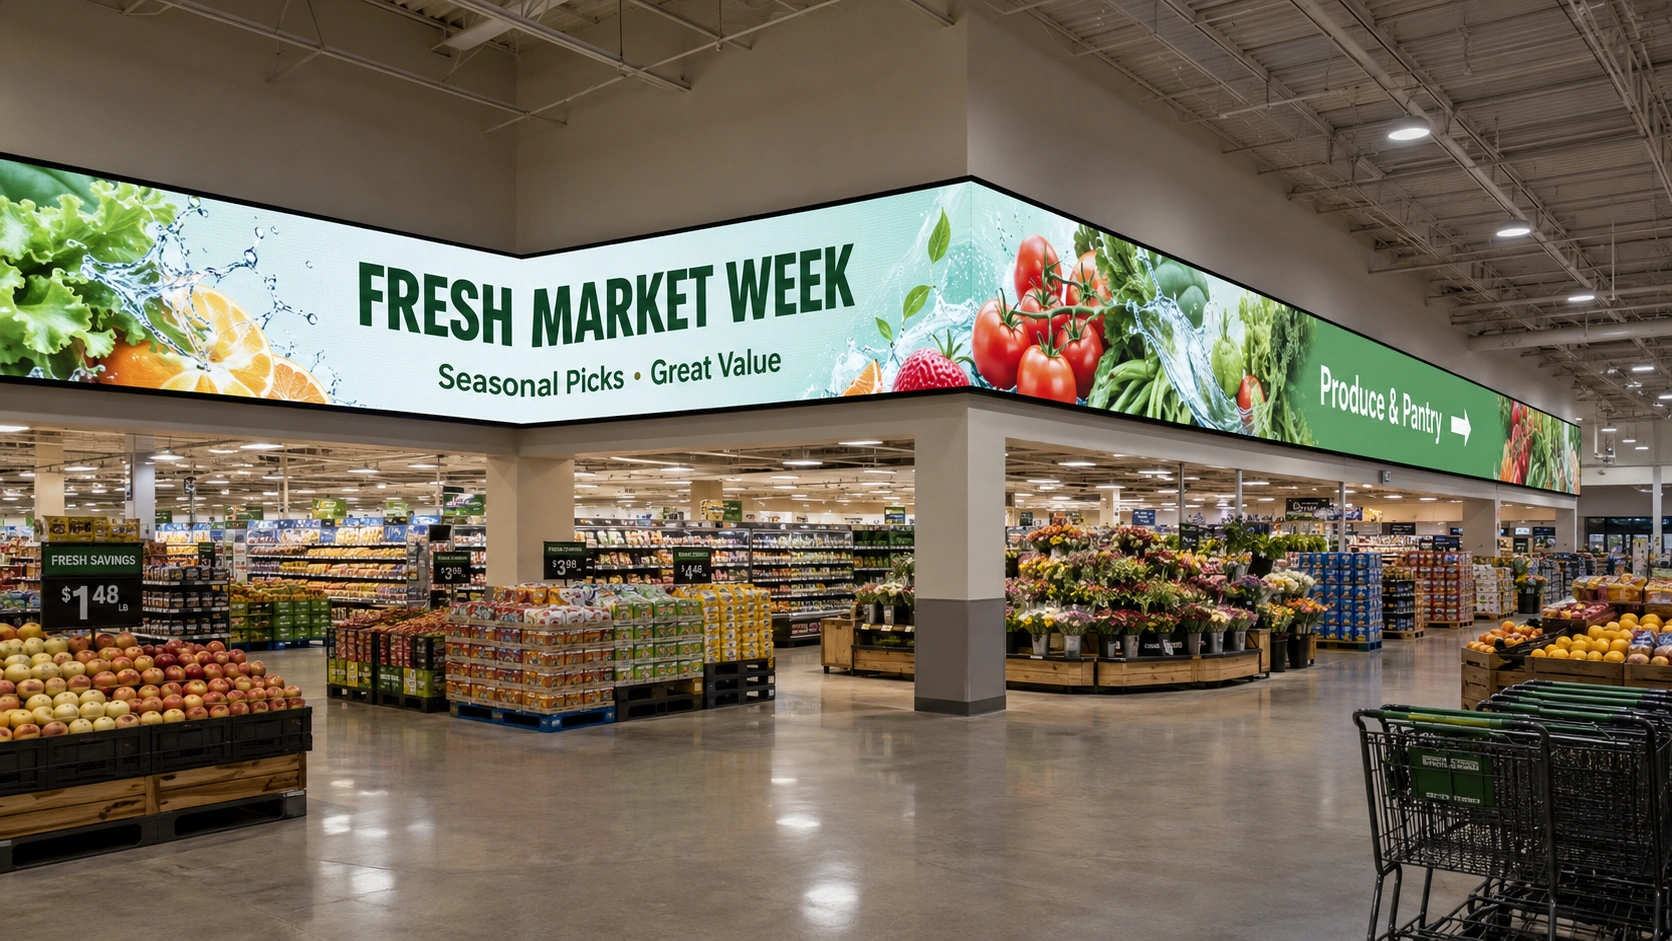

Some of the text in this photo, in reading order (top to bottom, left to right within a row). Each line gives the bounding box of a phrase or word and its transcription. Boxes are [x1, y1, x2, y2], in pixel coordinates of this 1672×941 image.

[359, 243, 855, 348] FRESH MARKET WEEK
[438, 363, 559, 398] Seasonal
[566, 366, 625, 394] Picks
[650, 355, 712, 385] Great
[717, 348, 782, 378] Value
[1320, 364, 1443, 445] Produce & Pantry
[51, 554, 136, 566] FRESH SAVINGS
[118, 603, 129, 612] LB
